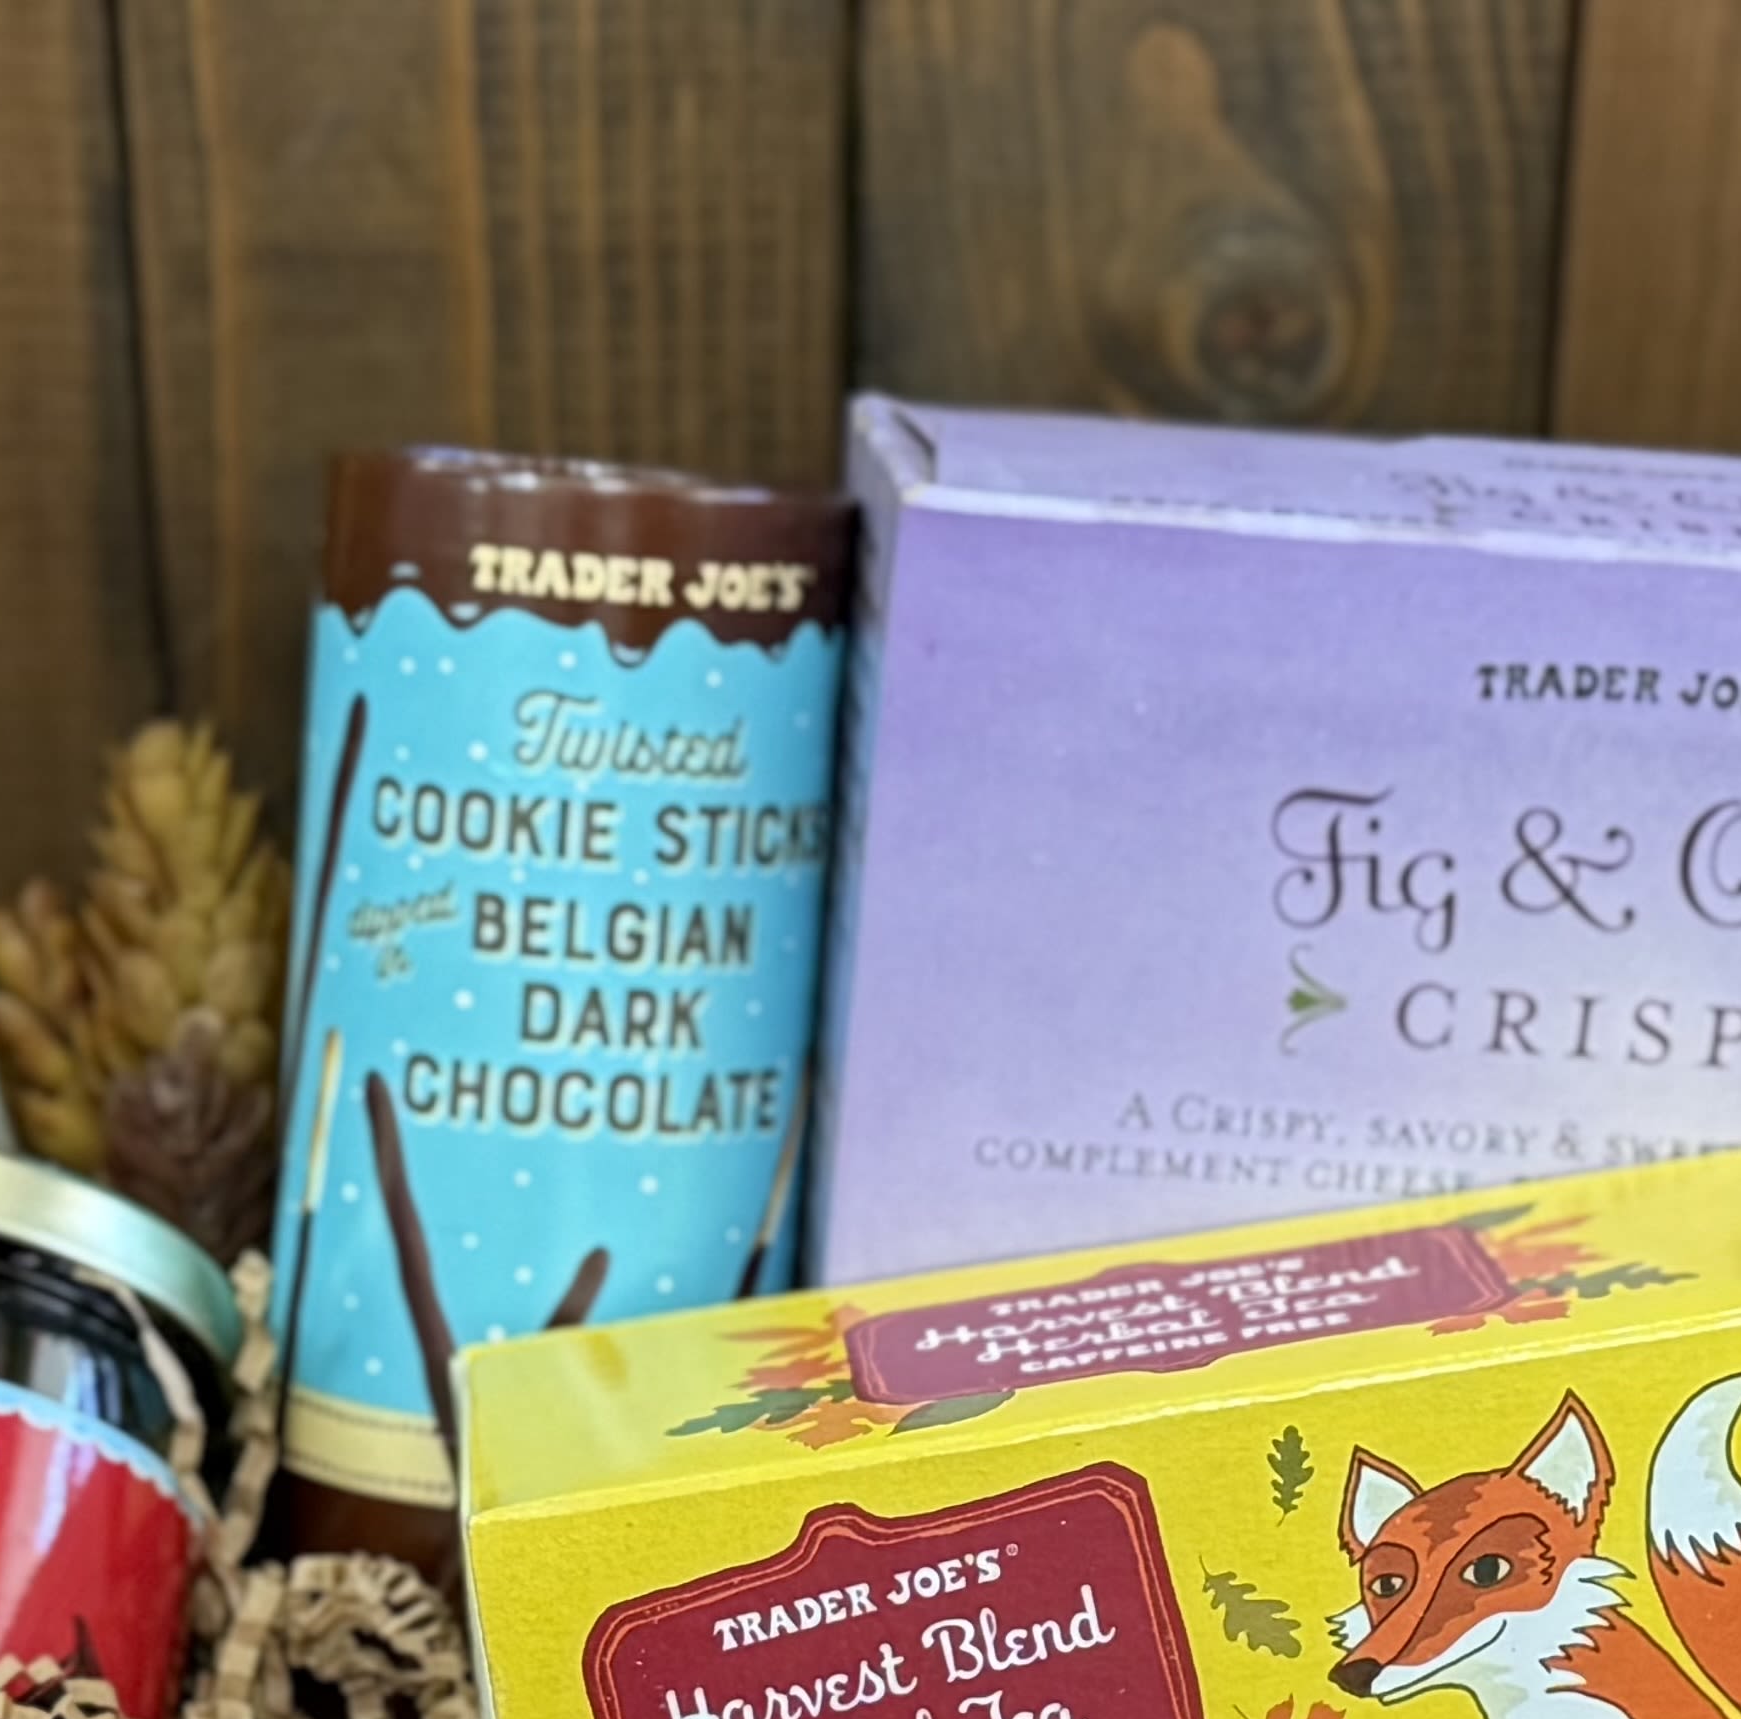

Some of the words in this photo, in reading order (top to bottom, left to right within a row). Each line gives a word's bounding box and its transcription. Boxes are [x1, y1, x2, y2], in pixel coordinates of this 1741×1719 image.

[469, 544, 674, 607] TRADER
[684, 561, 814, 611] JOE'S
[1475, 663, 1662, 707] TRADER
[513, 689, 748, 781] Twisted
[371, 776, 618, 864] COOKIE
[1270, 785, 1458, 955] Fig
[1498, 806, 1636, 933] &
[472, 892, 753, 967] BELGIAN
[520, 982, 704, 1050] DARK
[402, 1052, 779, 1134] CHOCOLATE
[1116, 1092, 1154, 1131] A
[1556, 1120, 1584, 1160] &
[974, 1136, 1292, 1191] COMPLEMENT
[914, 1292, 1198, 1352] Harvest
[1209, 1256, 1421, 1303] Blend
[988, 1279, 1165, 1318] TRADER
[1178, 1256, 1304, 1289] JOE'S
[976, 1313, 1222, 1364] Herbal
[1238, 1292, 1380, 1321] Tea
[1019, 1330, 1228, 1374] CAFFEINE
[1240, 1311, 1351, 1340] FREE
[712, 1582, 878, 1652] TRADER
[921, 1584, 1117, 1684] Blend
